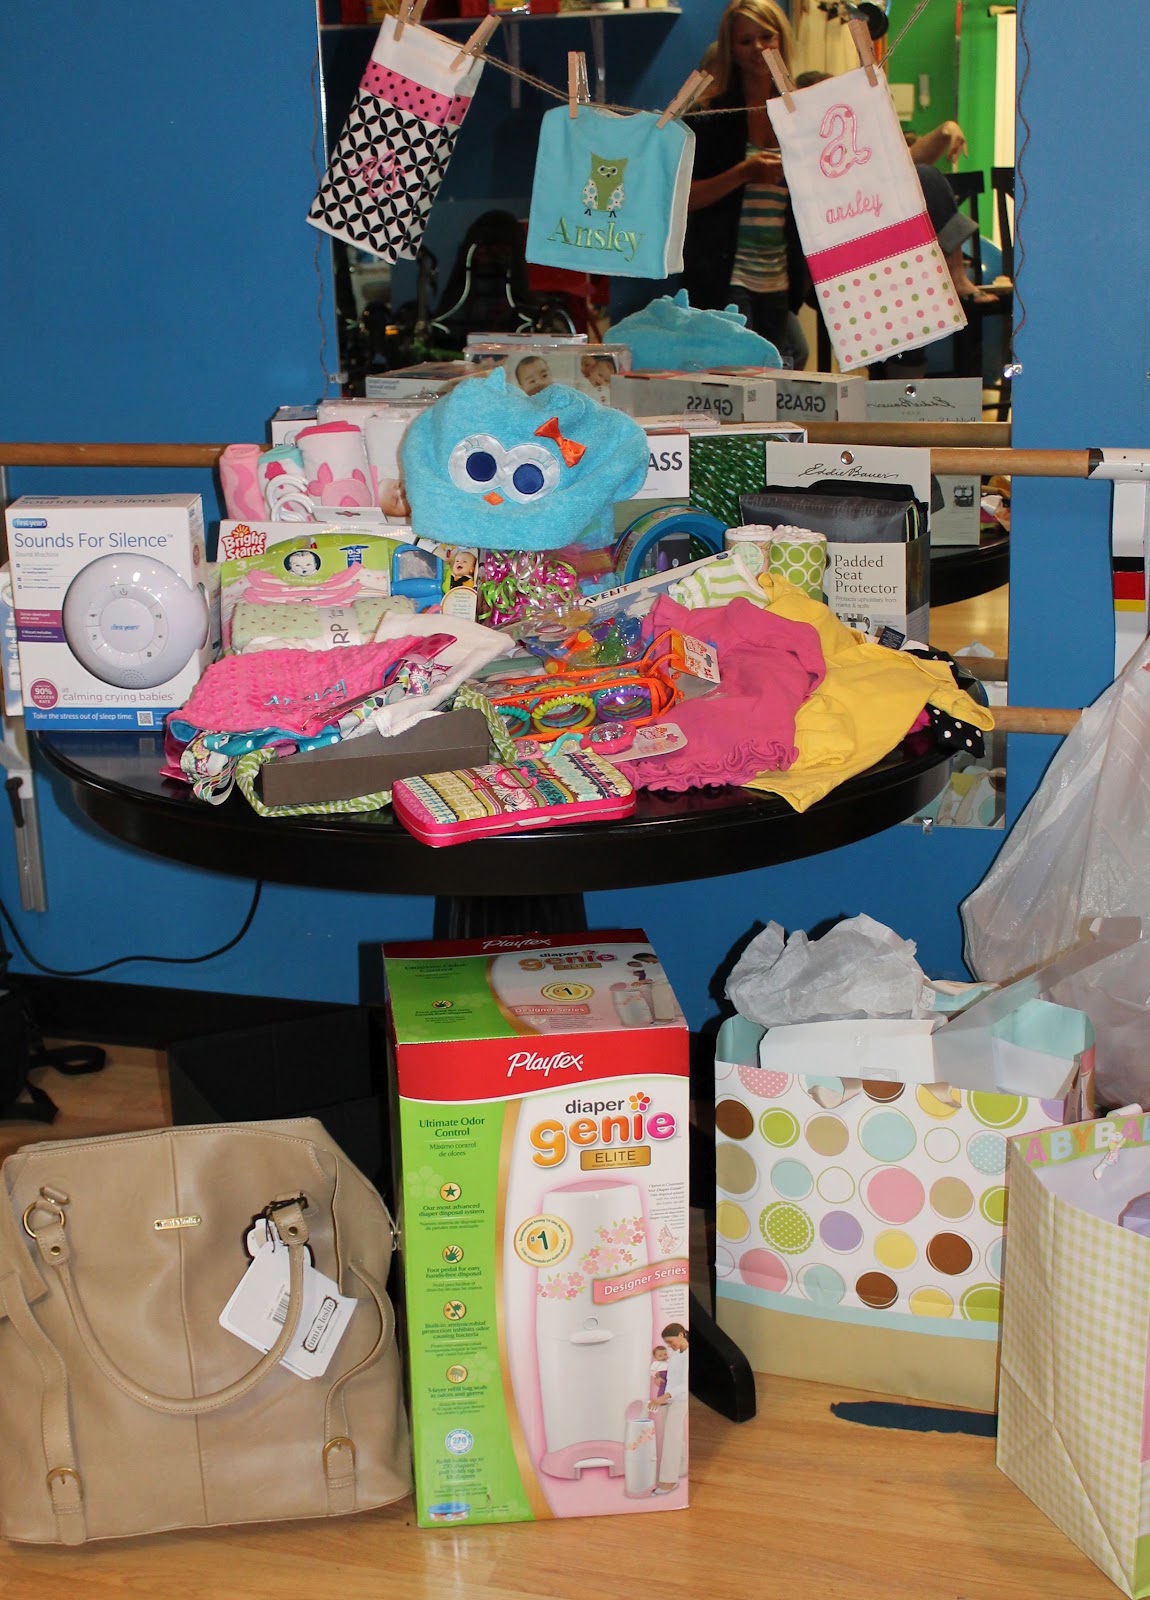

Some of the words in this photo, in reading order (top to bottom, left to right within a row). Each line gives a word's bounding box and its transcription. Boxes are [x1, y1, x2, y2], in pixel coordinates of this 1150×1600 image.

[825, 191, 883, 225] ansley
[547, 217, 646, 262] Ansley
[649, 451, 683, 472] ASS
[798, 463, 847, 477] Eddie
[846, 465, 899, 479] Bauer
[14, 533, 74, 548] Sounds
[78, 533, 104, 548] For
[222, 531, 266, 550] Bright
[226, 545, 264, 561] Starts
[834, 554, 884, 568] Padded
[834, 567, 863, 581] Seat
[835, 580, 899, 594] Protector
[583, 584, 630, 606] AVENT
[34, 687, 52, 695] 90%
[63, 692, 102, 702] calming
[139, 692, 173, 700] babies
[32, 712, 48, 720] Take
[90, 712, 99, 721] of
[99, 713, 117, 722] sleep
[482, 938, 551, 950] Playtex
[518, 953, 616, 972] genie
[506, 1051, 583, 1077] Playtex
[565, 1100, 625, 1115] diaper
[419, 1119, 459, 1128] Ultimate
[460, 1117, 486, 1125] Odor
[434, 1128, 470, 1138] Control
[529, 1111, 677, 1168] genie
[595, 1150, 636, 1163] ELITE
[603, 1274, 653, 1296] Designer
[654, 1266, 687, 1280] Series
[452, 1436, 467, 1444] 270
